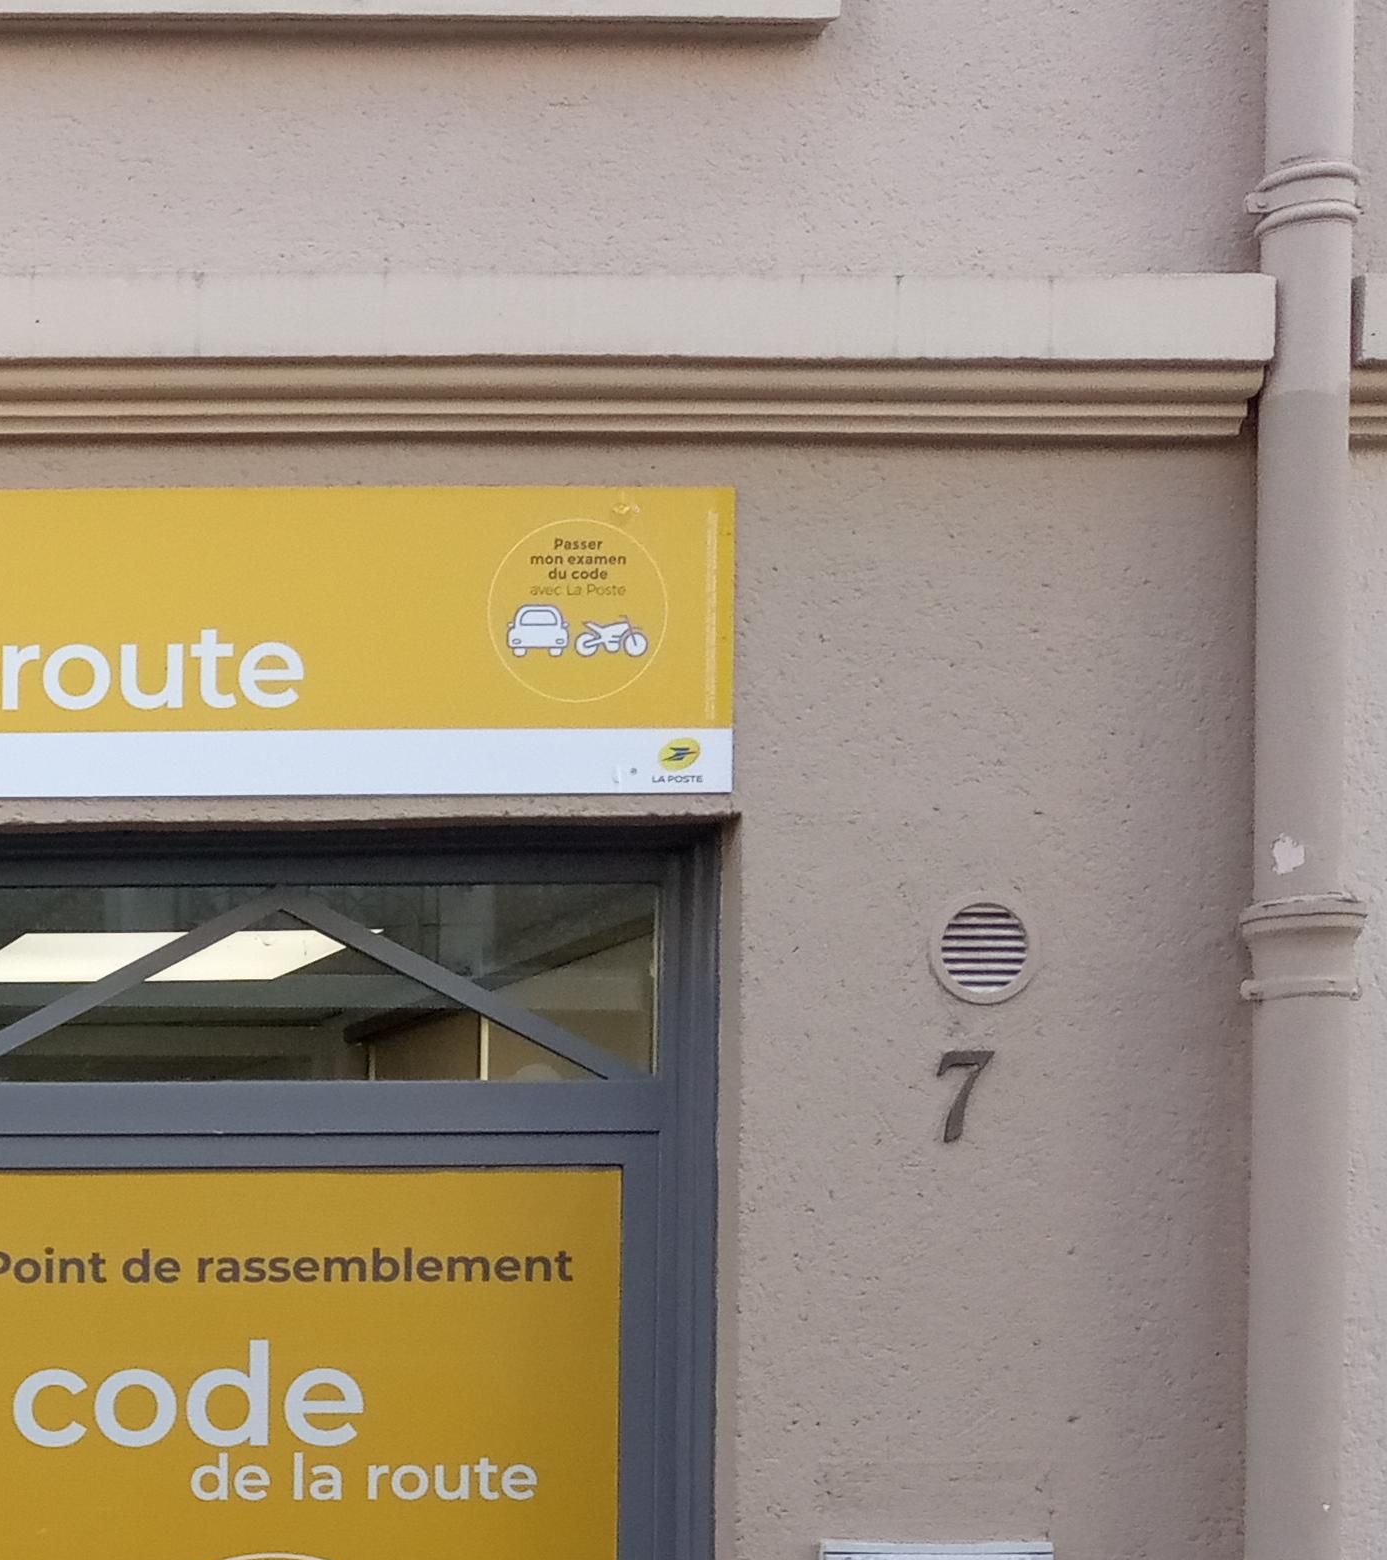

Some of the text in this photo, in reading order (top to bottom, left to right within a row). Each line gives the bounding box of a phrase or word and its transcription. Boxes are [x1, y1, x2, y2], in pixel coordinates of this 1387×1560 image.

[554, 538, 603, 550] Passer
[531, 555, 626, 565] mon examen
[549, 568, 607, 580] du code
[530, 584, 626, 596] avec La Poste
[2, 629, 304, 710] route
[668, 775, 703, 783] POSTE
[934, 1050, 995, 1144] 7
[123, 1249, 180, 1283] de
[198, 1247, 573, 1283] rassemblement
[13, 1340, 364, 1447] code
[191, 1452, 538, 1500] de la route
